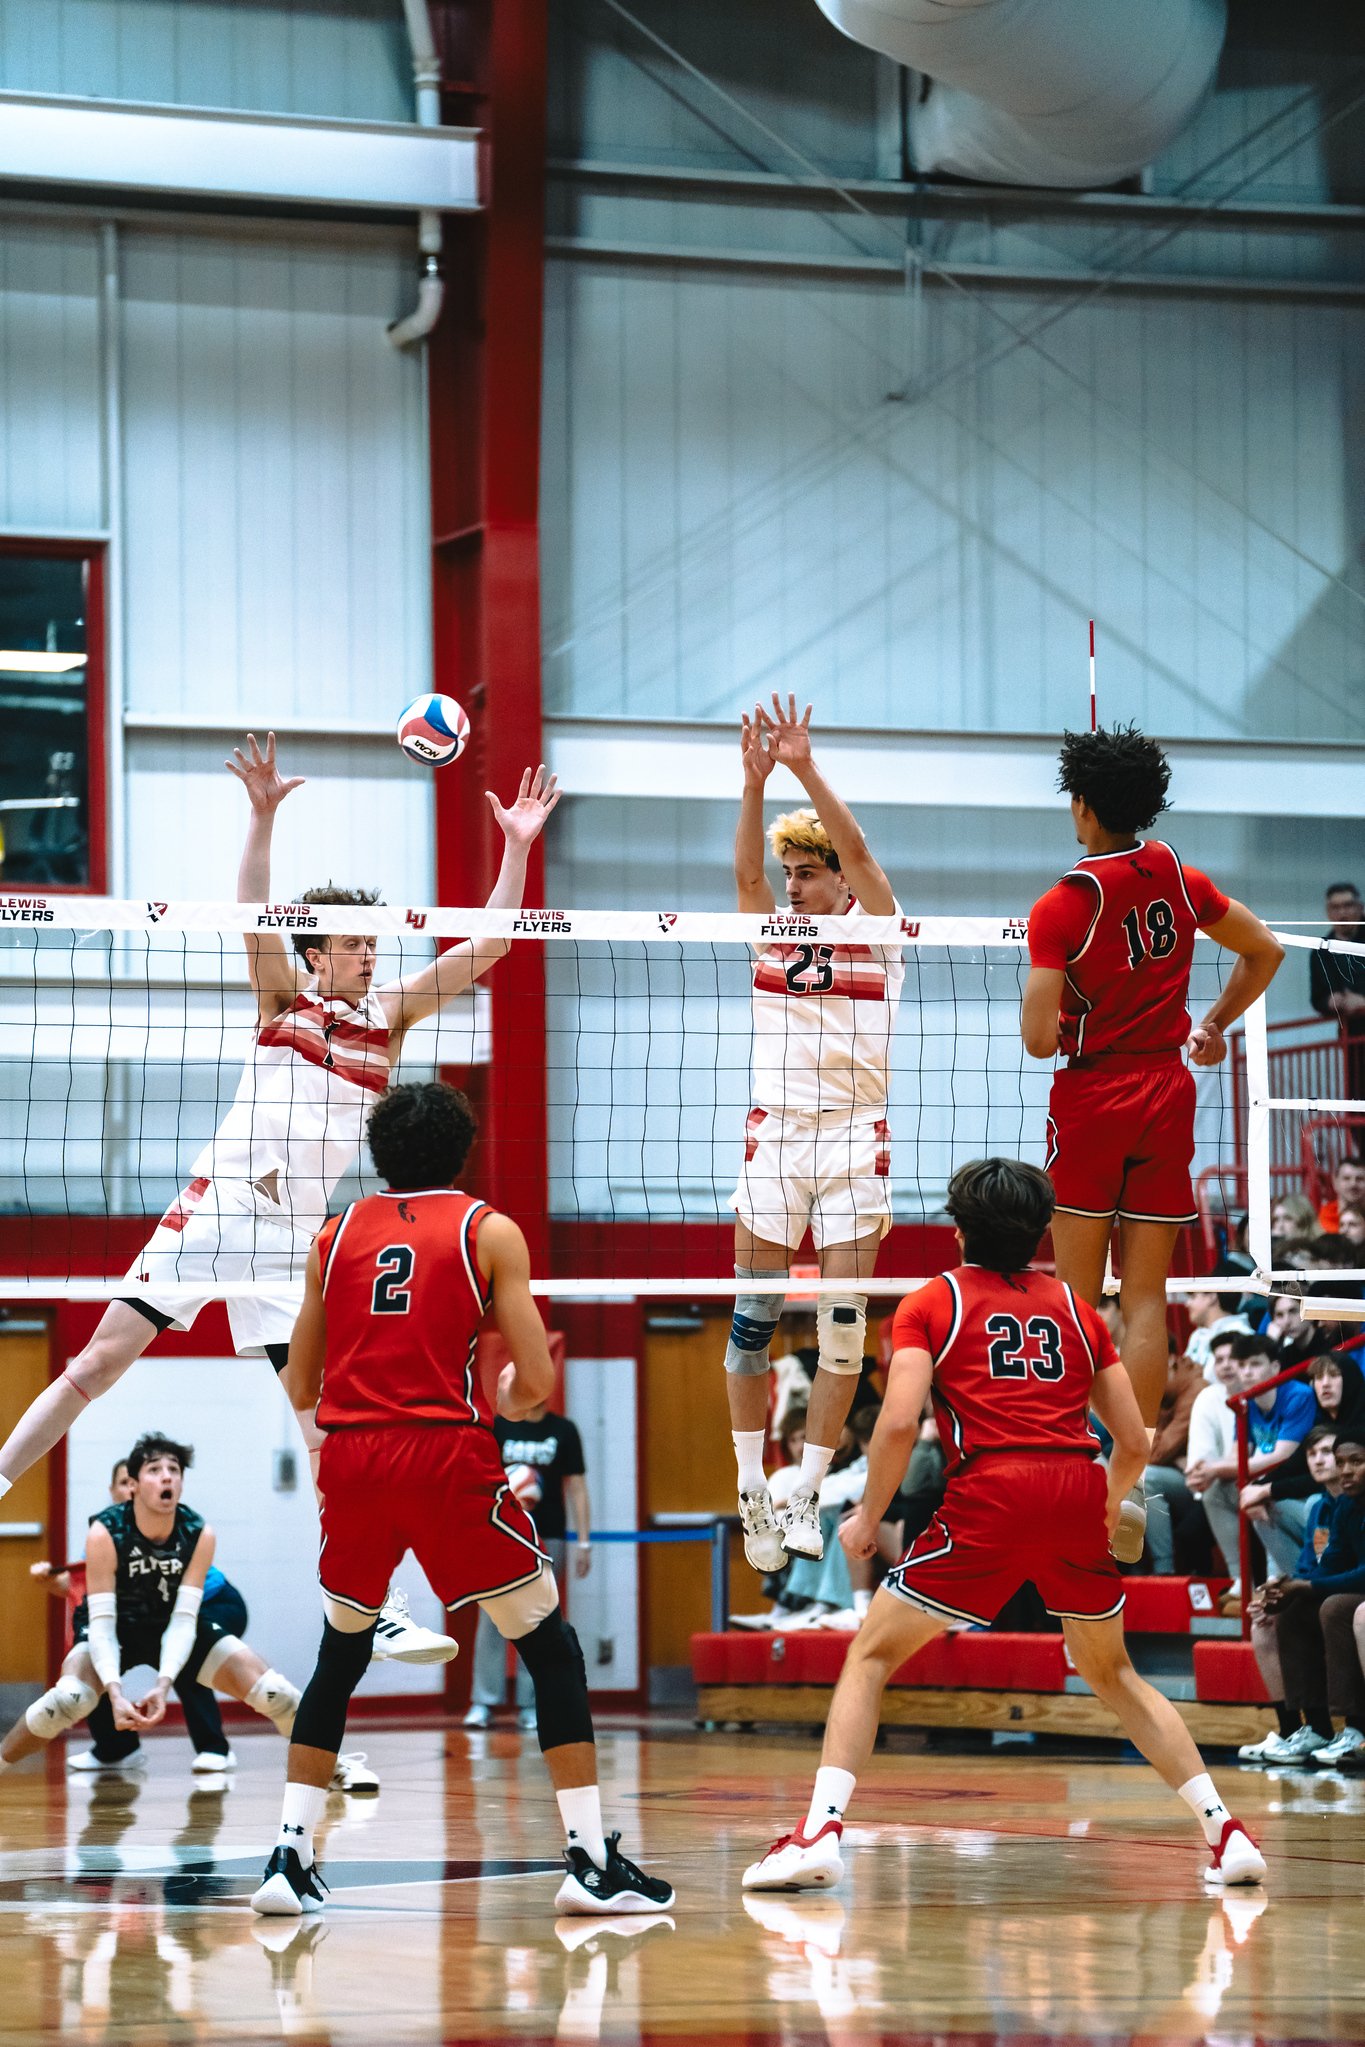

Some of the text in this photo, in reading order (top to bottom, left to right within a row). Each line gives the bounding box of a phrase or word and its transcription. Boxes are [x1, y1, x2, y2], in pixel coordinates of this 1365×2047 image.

[414, 739, 440, 758] NCAA
[0, 898, 47, 909] LEWIS
[265, 904, 311, 915] LEWIS
[0, 909, 54, 922] LYERS
[257, 915, 318, 928] FLYERS
[405, 909, 427, 930] LU
[520, 910, 565, 921] LEWIS
[768, 915, 811, 925] LEWIS
[513, 920, 572, 933] FLYERS
[900, 917, 921, 938] LU
[1009, 918, 1029, 928] LE
[761, 925, 819, 937] FLYERS
[1121, 898, 1178, 971] 18
[785, 942, 835, 994] 23
[370, 1244, 416, 1315] 2
[985, 1313, 1066, 1382] 23
